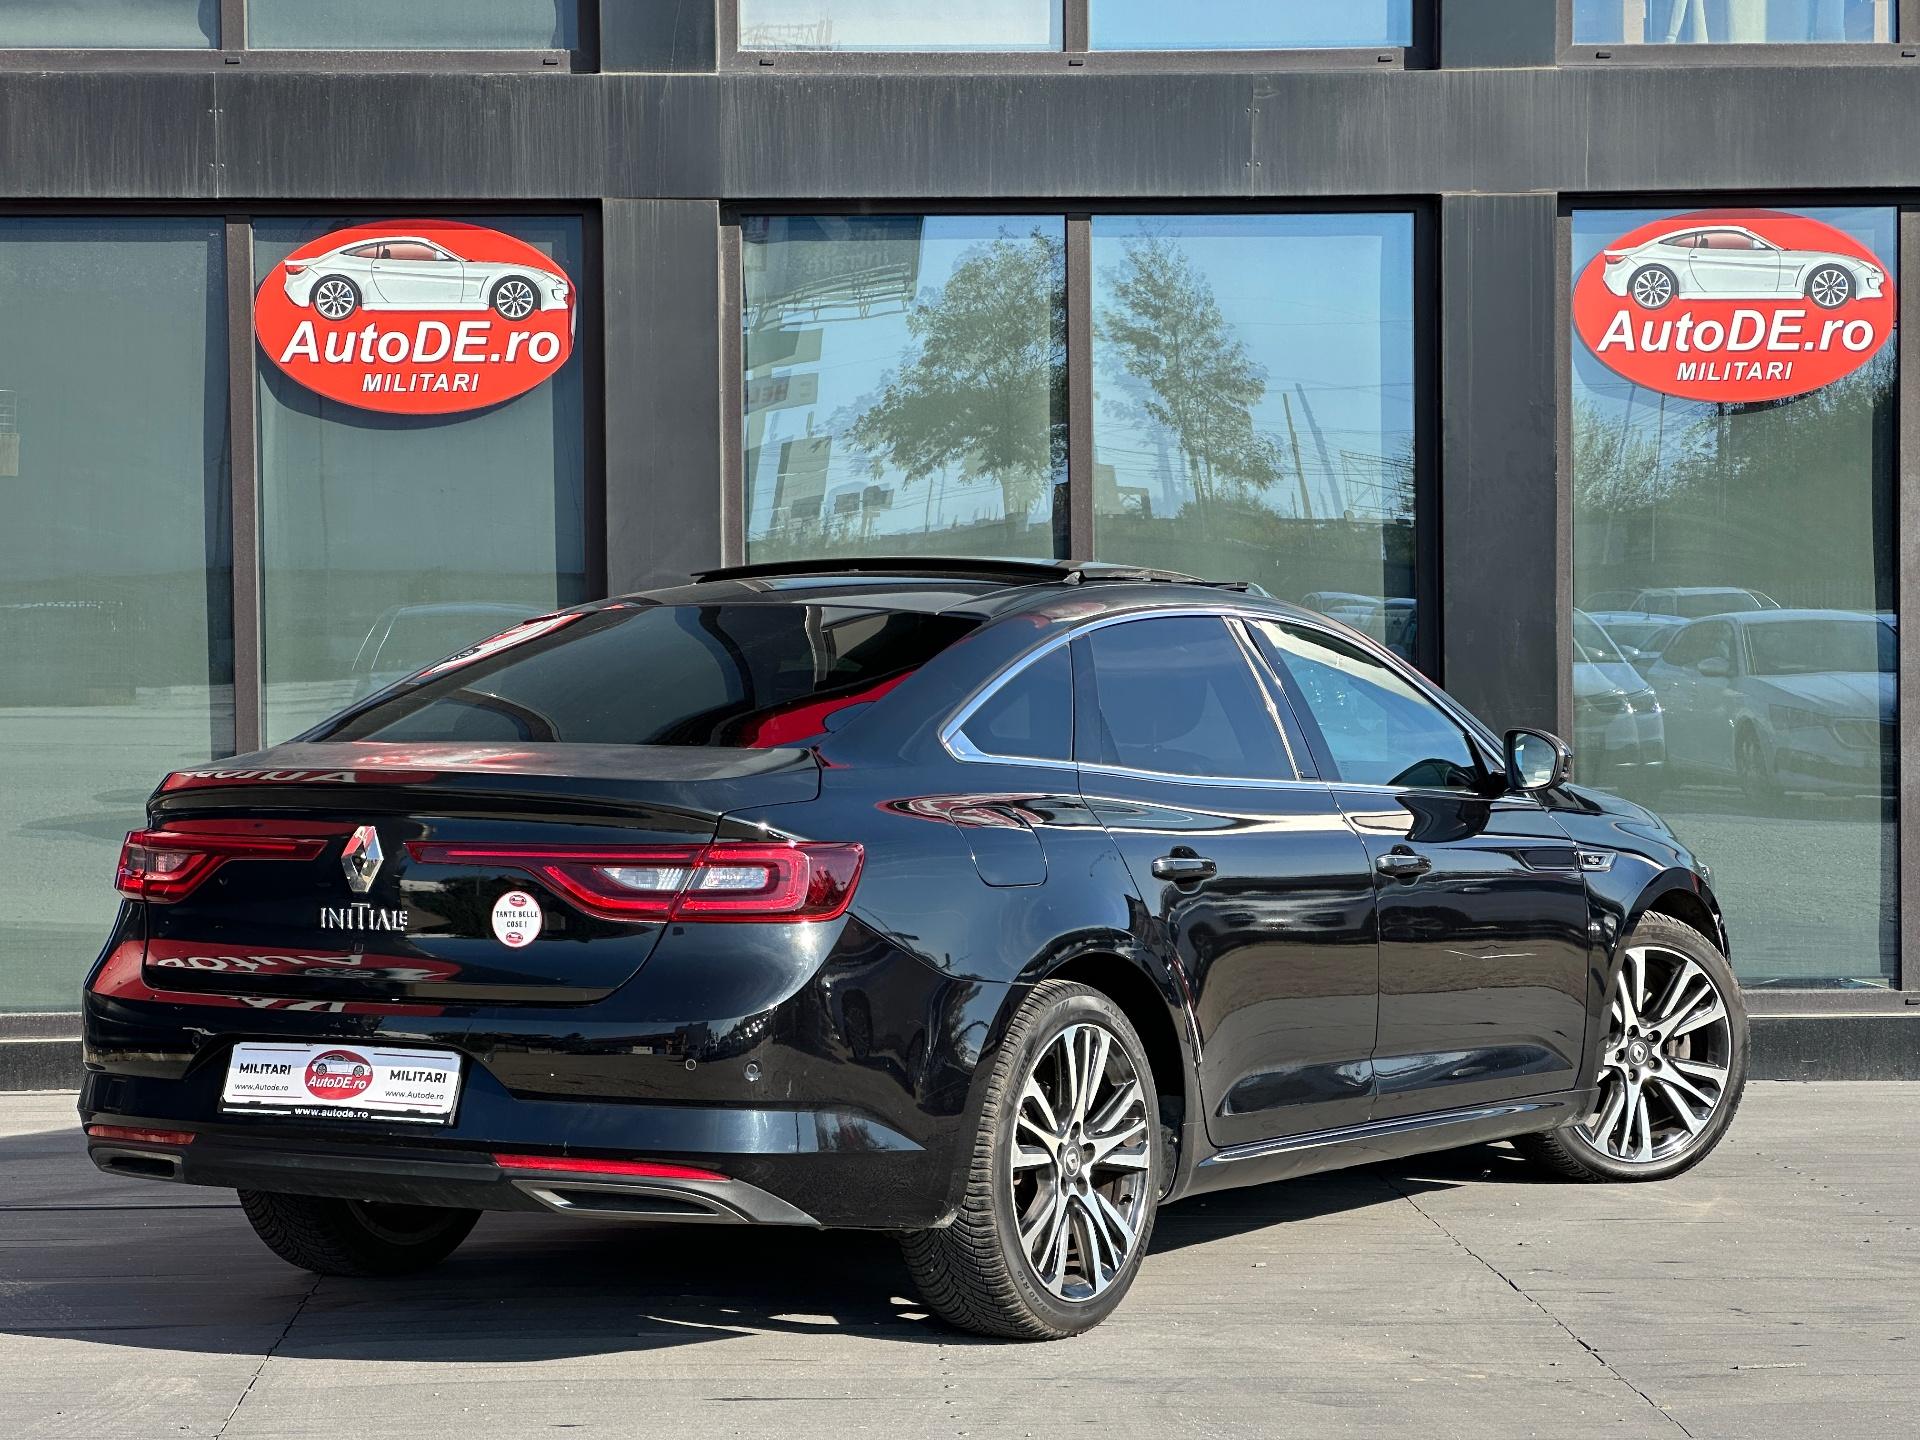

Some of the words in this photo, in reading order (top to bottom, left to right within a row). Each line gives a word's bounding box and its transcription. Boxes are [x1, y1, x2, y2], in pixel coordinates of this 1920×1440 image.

[1596, 309, 1875, 352] AutoDE.ro
[279, 320, 560, 364] AutoDE.ro
[1676, 361, 1793, 382] MILITARI
[361, 373, 480, 393] MILITARI
[320, 902, 408, 931] INITIALE
[495, 910, 517, 918] TANTE
[518, 910, 539, 918] BELLE
[506, 920, 523, 928] COSE
[239, 1062, 292, 1075] MILITARI
[307, 1075, 367, 1090] AutoDE.ro
[389, 1069, 448, 1084] MILITARI
[234, 1083, 289, 1092] www.Autode.ro
[384, 1090, 445, 1101] www.Autode.ro
[294, 1108, 369, 1119] www.autode.ro
